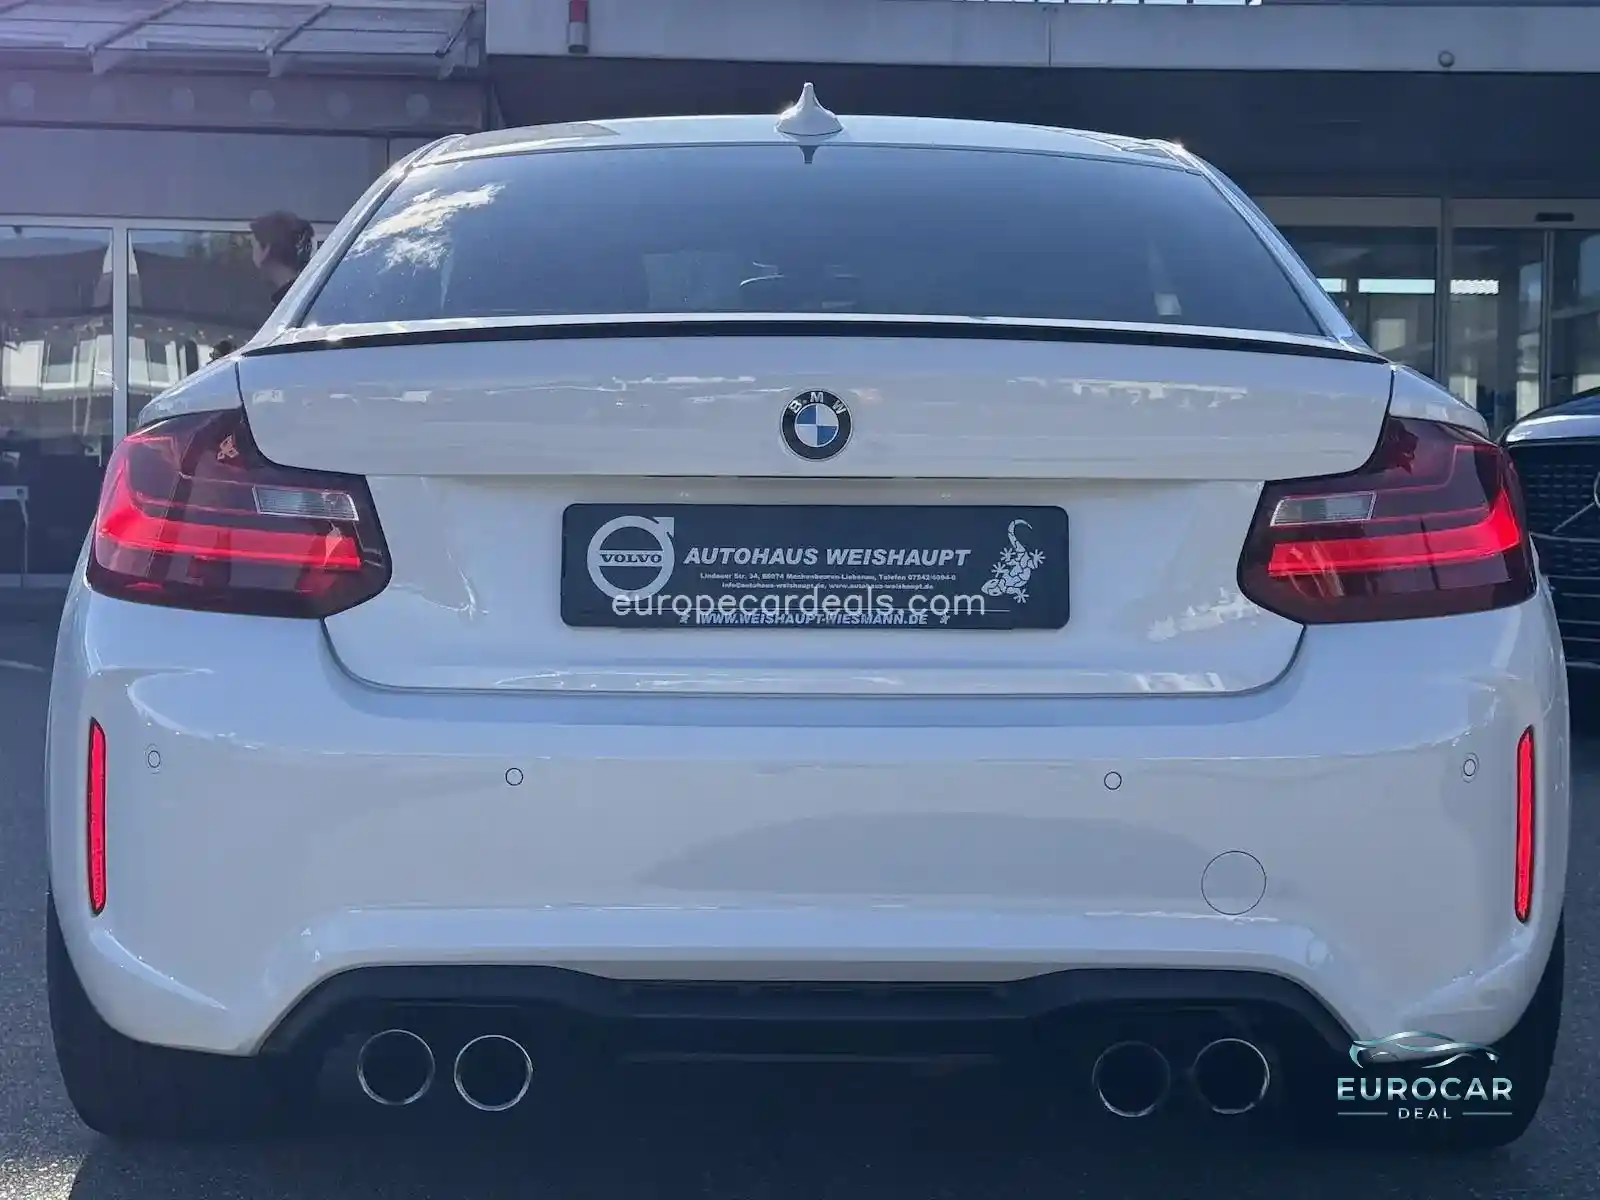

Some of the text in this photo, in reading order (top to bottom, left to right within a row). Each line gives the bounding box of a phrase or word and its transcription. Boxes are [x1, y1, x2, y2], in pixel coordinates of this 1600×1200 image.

[600, 553, 662, 563] VOLVO
[683, 547, 971, 566] AUTOHAUS WEISHAUPT
